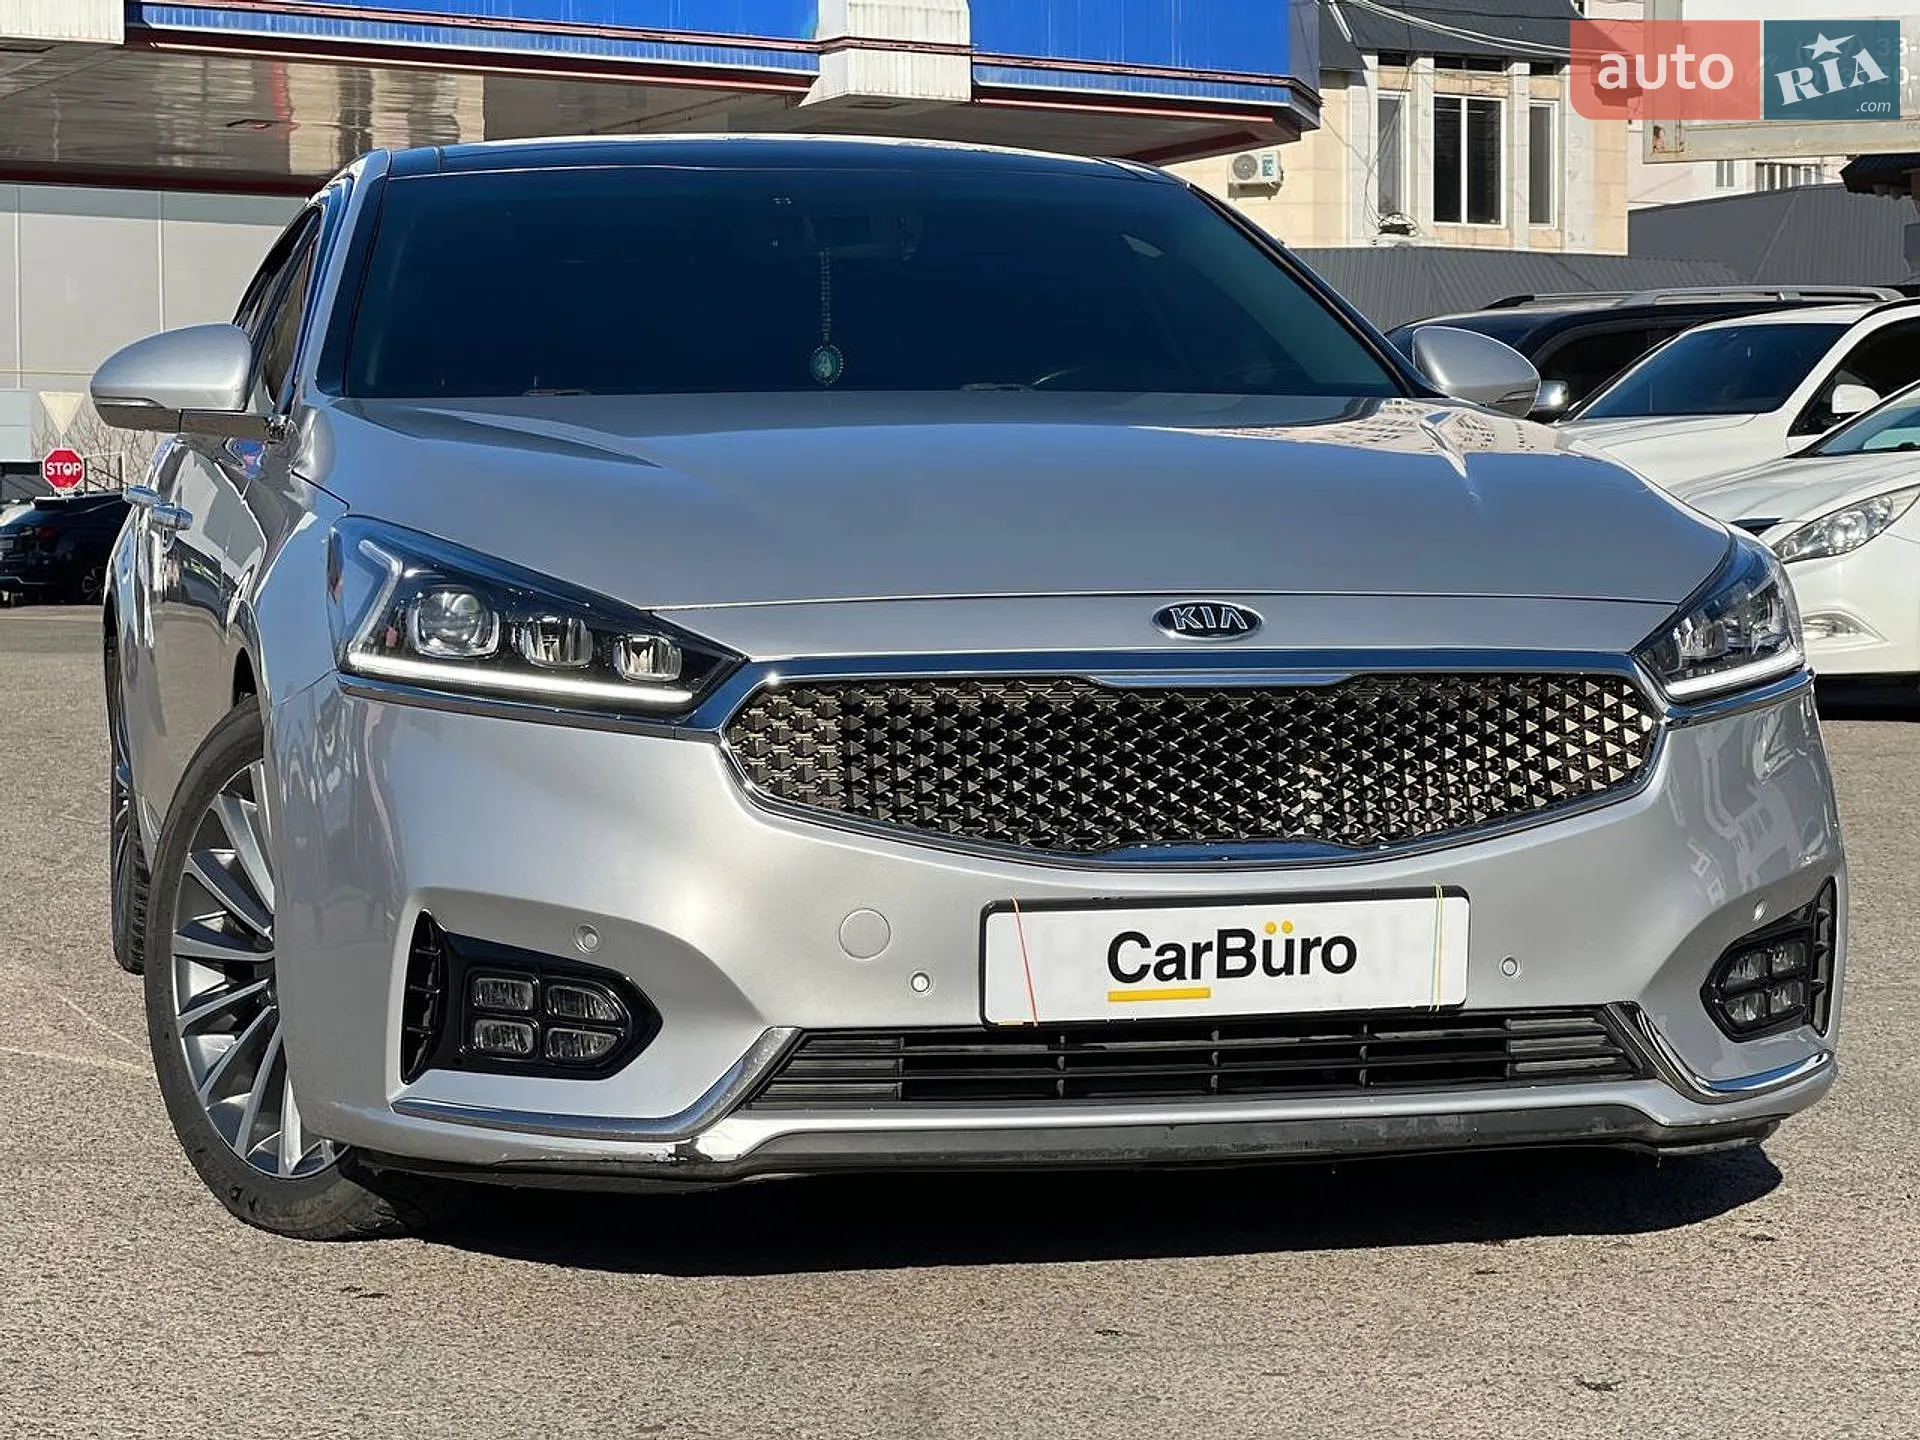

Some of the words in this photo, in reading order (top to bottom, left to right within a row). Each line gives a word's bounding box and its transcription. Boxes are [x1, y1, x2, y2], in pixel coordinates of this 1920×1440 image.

[46, 462, 82, 476] STOP
[1169, 606, 1248, 630] KIA
[1107, 920, 1358, 984] CarBüro
